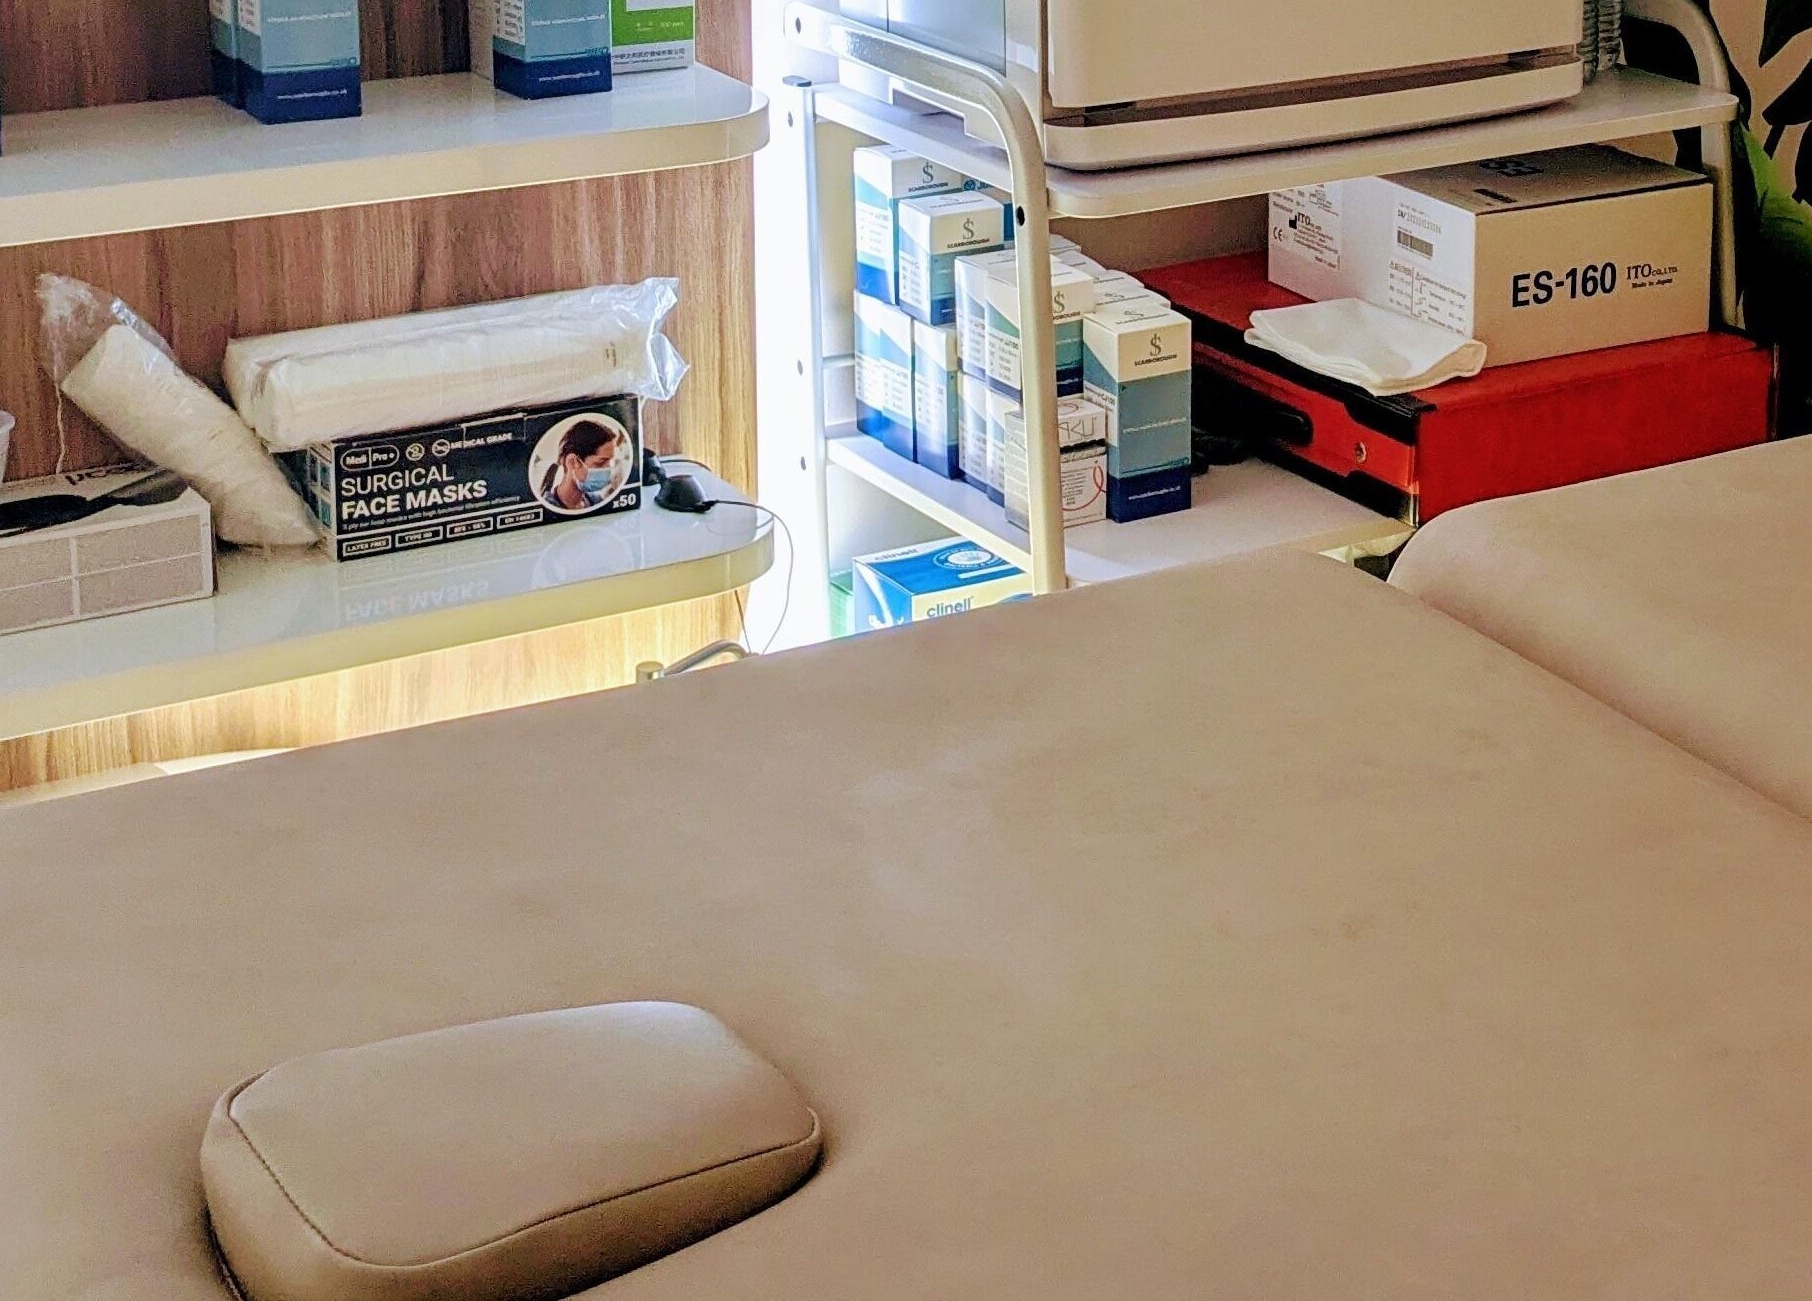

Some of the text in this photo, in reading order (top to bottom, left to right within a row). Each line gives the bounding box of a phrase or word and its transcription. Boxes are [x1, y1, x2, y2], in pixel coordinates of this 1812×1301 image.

[908, 182, 949, 193] SCARBOROUGH
[1298, 212, 1311, 225] ITO
[946, 238, 990, 249] SCARBOROUGH
[1626, 263, 1652, 281] ITO
[1512, 262, 1617, 308] ES-160
[1656, 278, 1673, 287] Japan
[1134, 354, 1178, 367] SCARBOROUGH
[450, 433, 513, 449] MEDICAL GRADE
[346, 455, 367, 465] Medi
[341, 463, 455, 497] SURGICAL
[342, 480, 488, 520] FACE MASKS
[612, 493, 637, 509] x50
[405, 534, 422, 542] TYPE
[347, 539, 387, 552] LATEX FREE
[874, 549, 918, 561] clinell
[927, 598, 971, 618] clinell
